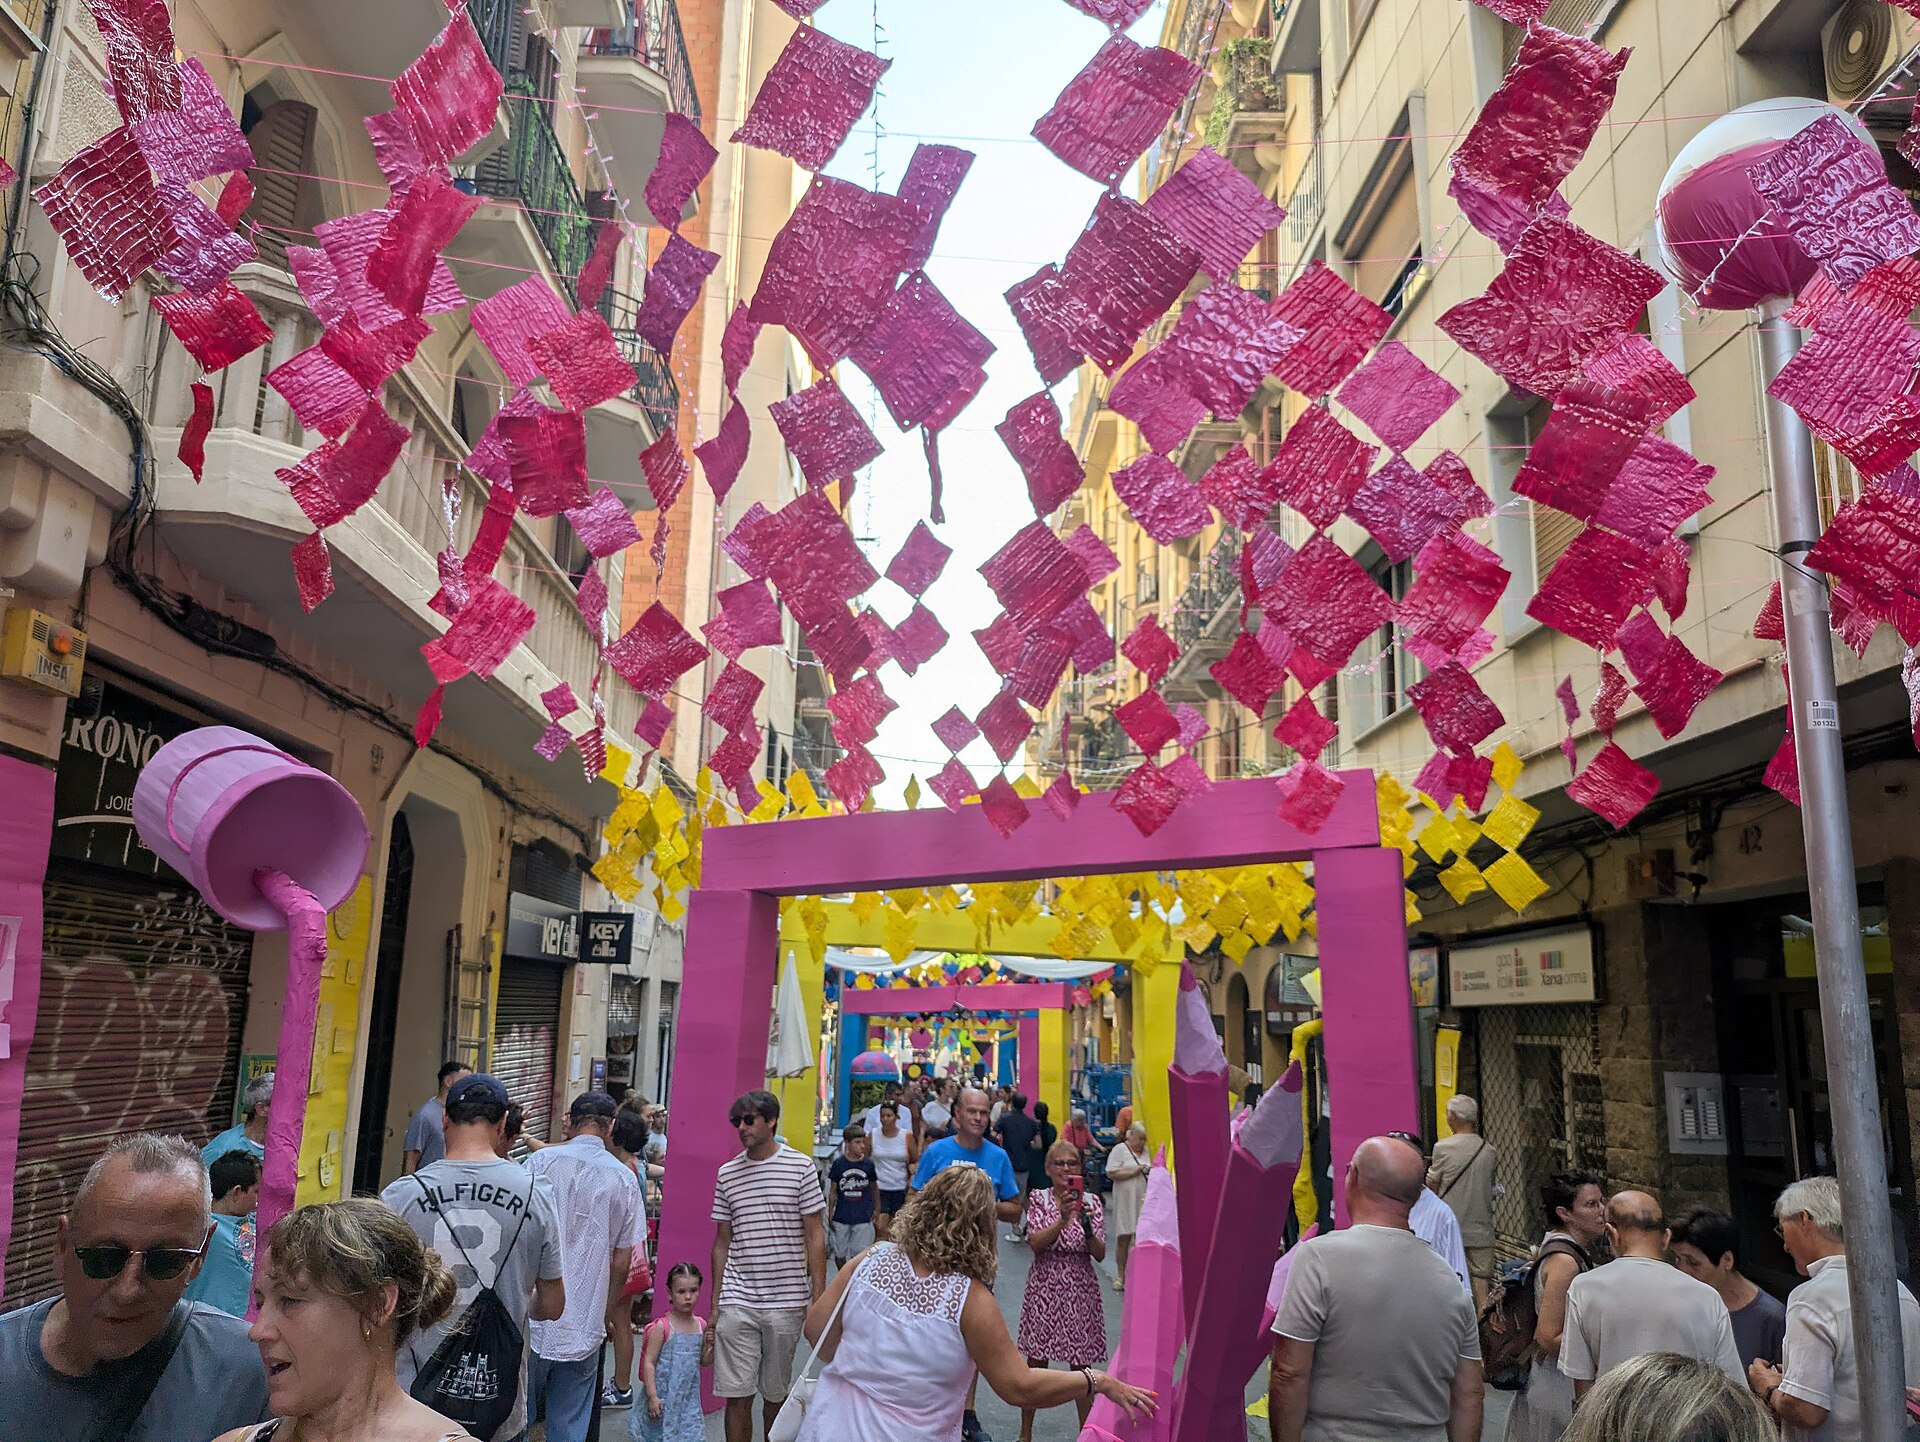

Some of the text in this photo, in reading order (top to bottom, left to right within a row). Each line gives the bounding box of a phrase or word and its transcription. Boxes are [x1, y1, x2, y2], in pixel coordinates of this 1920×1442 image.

[38, 653, 69, 683] INSA
[541, 916, 565, 955] KEY
[590, 923, 625, 940] KEY
[416, 1183, 524, 1216] HILFIGER
